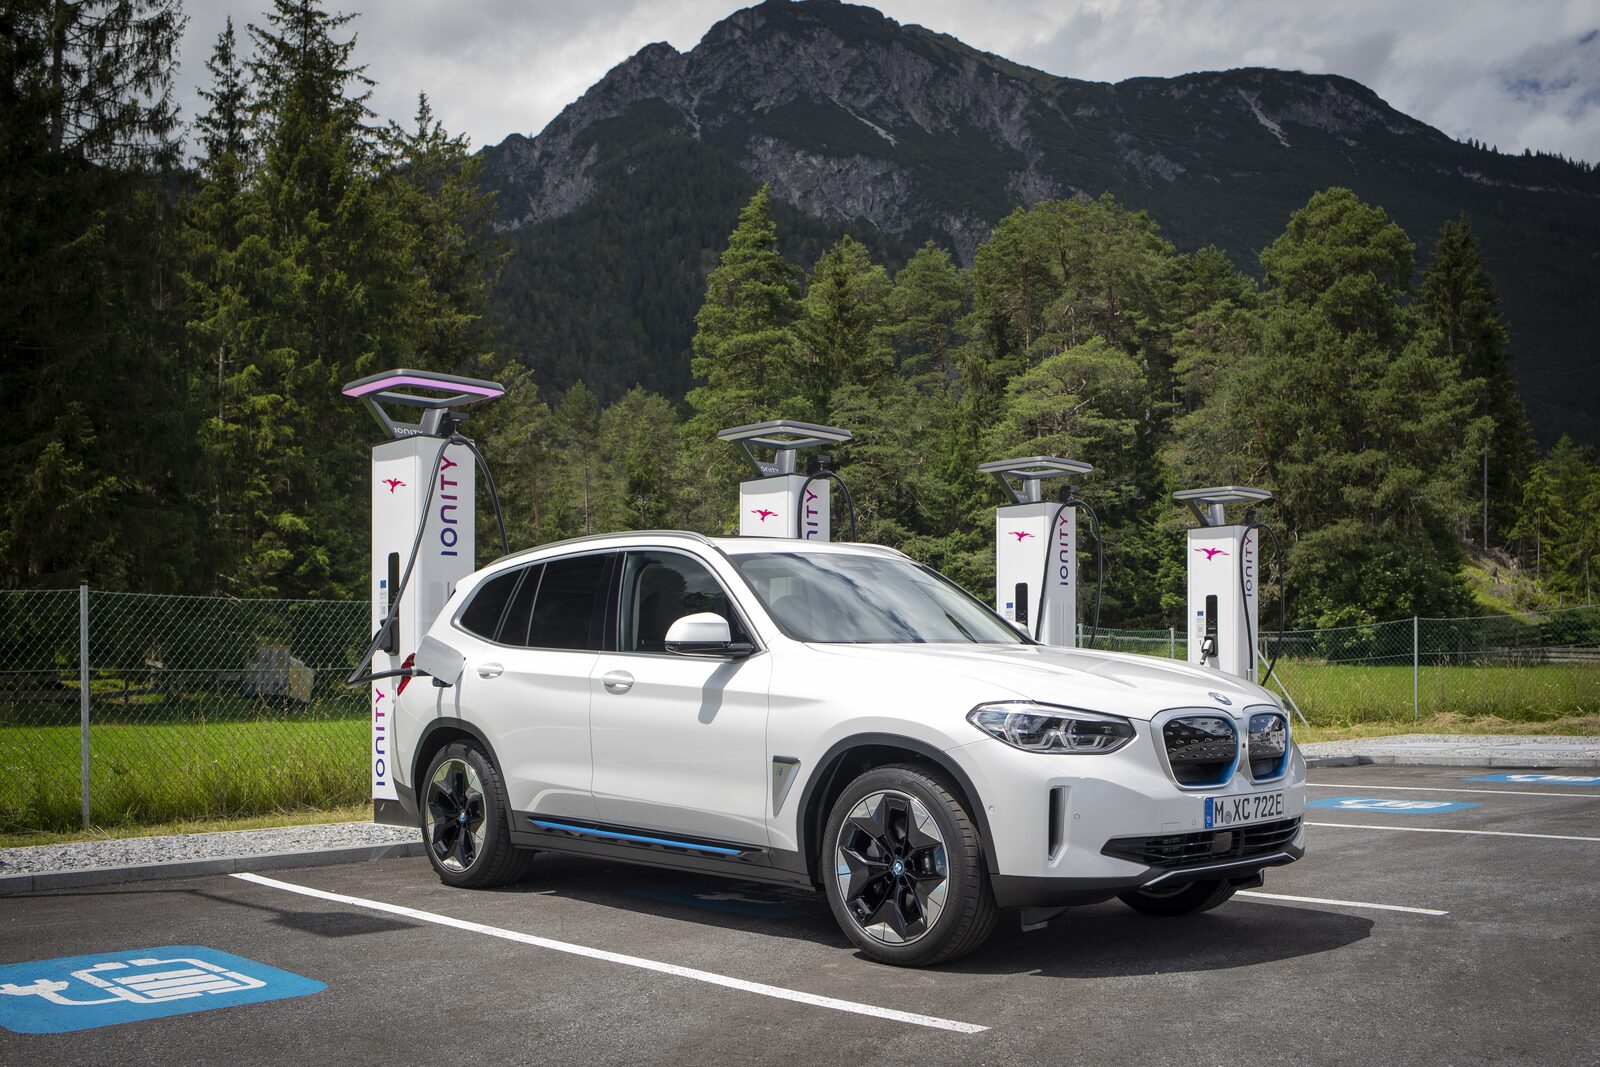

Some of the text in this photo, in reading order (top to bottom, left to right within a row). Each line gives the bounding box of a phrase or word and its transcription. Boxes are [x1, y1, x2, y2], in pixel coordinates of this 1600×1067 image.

[440, 454, 458, 556] IONITY
[806, 489, 818, 540] NITY
[1059, 515, 1069, 586] IONITY
[375, 687, 386, 786] IONITY
[1254, 793, 1283, 819] 722E
